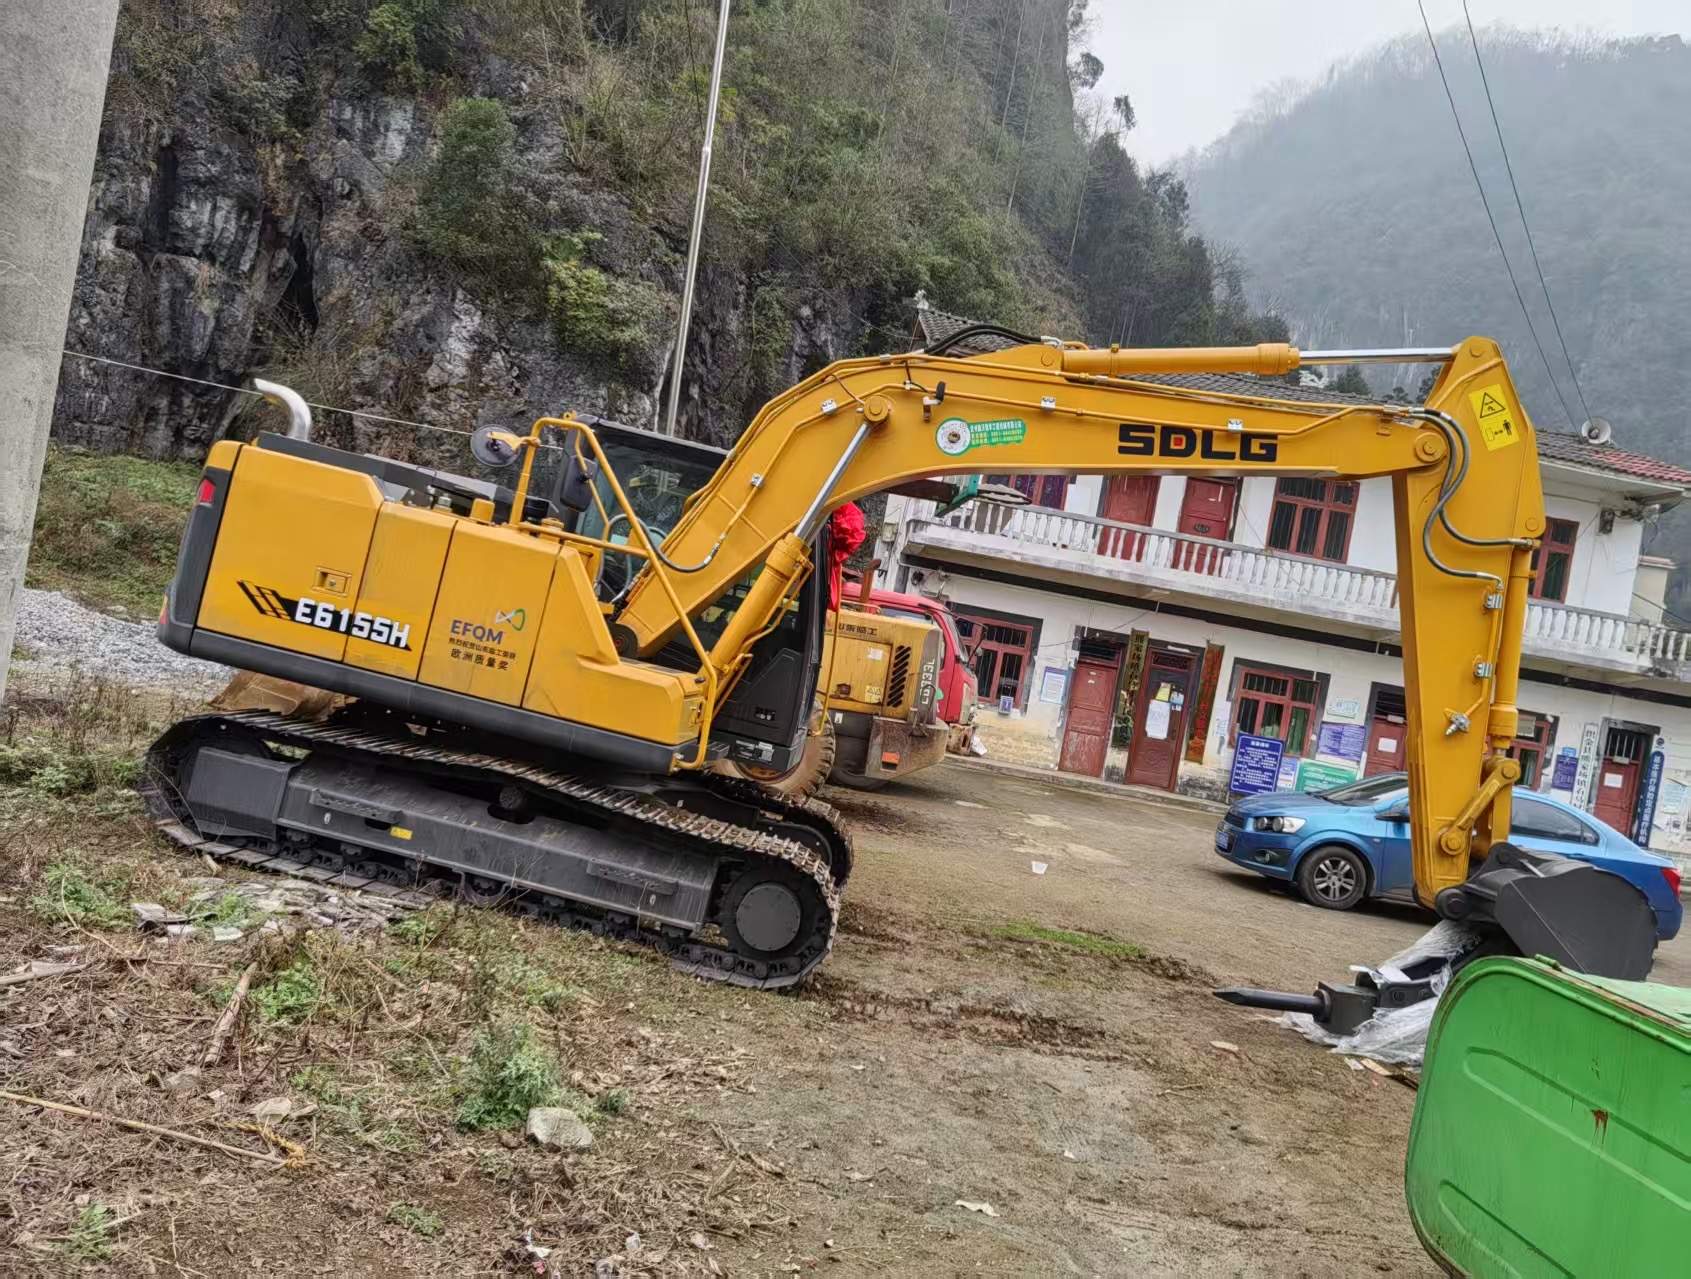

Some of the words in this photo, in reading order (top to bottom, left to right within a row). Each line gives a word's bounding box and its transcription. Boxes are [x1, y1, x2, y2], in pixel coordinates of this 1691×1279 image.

[1118, 424, 1278, 462] SDLG
[451, 619, 504, 645] EFQM
[451, 648, 509, 671] 欧洲质量奖
